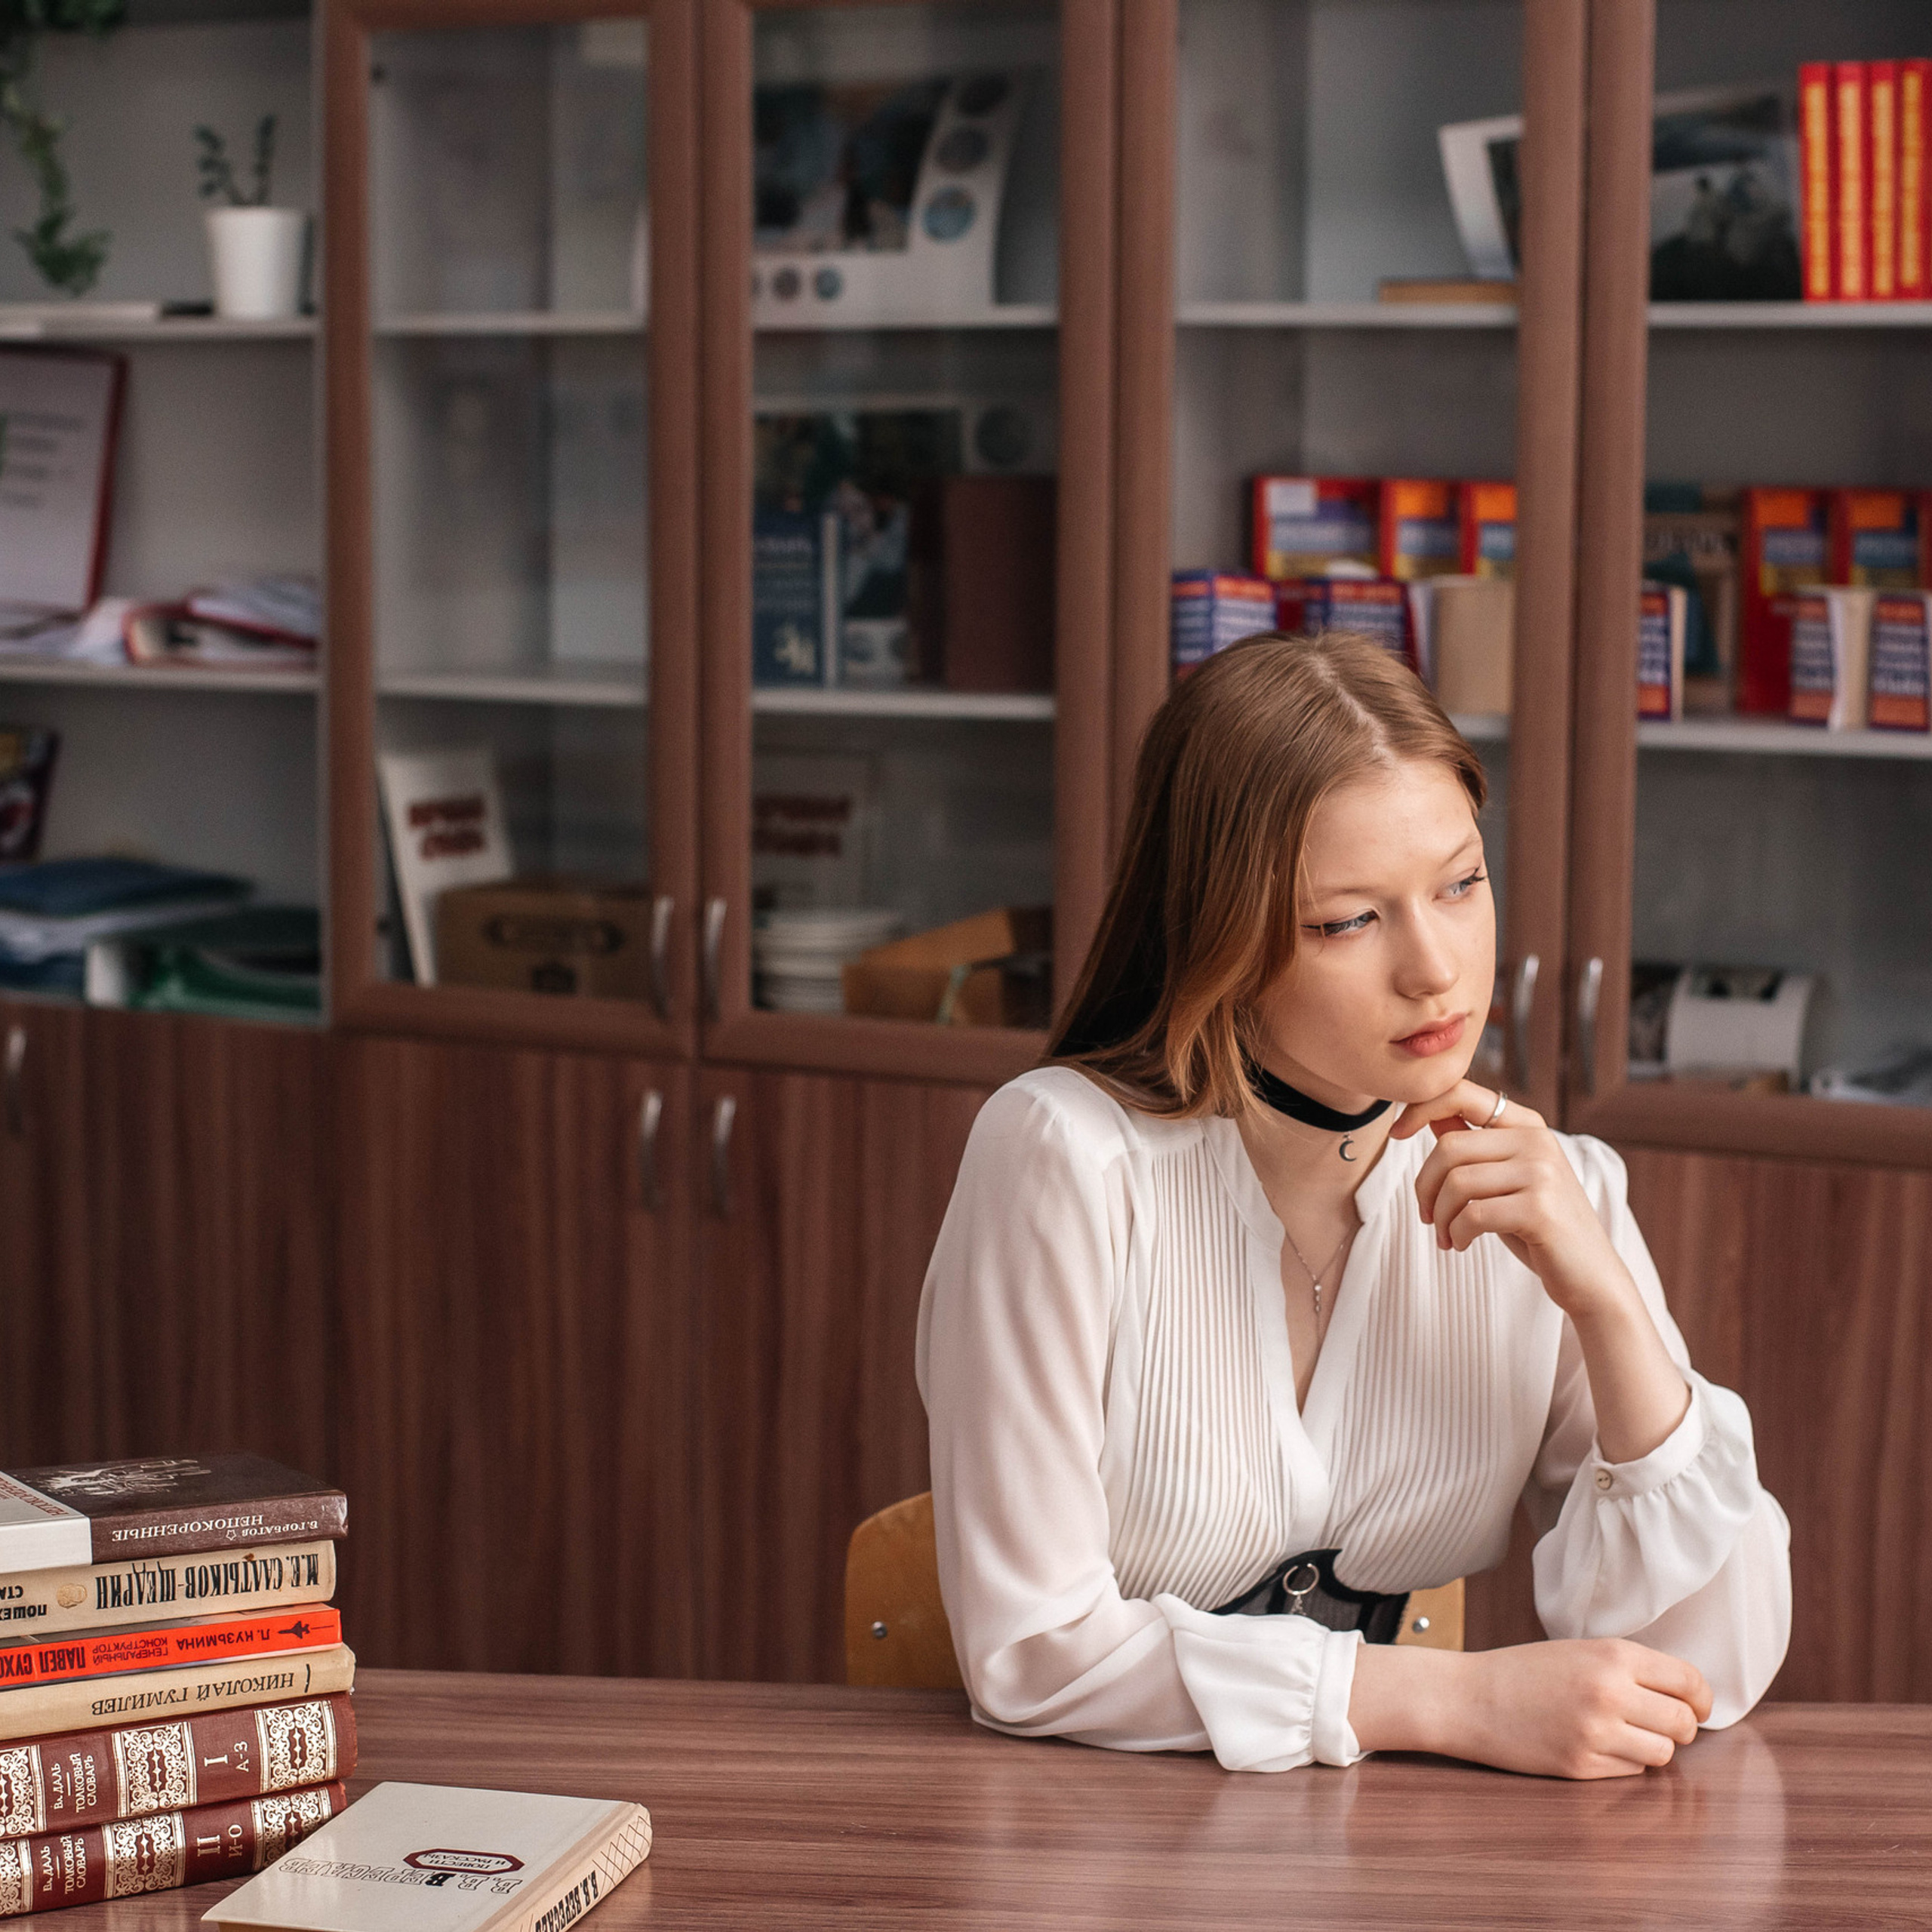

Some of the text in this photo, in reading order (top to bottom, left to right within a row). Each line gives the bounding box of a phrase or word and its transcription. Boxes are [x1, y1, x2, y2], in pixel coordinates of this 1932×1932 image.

[112, 1515, 264, 1542] НЕПОКОРЕННЫЕ
[95, 1558, 283, 1609] САЛТЫКОВ-ЩЕДРИН
[92, 1637, 168, 1654] КОНСТРУКТОР
[176, 1629, 254, 1651] КУЗЬМИНА
[38, 1647, 86, 1673] ПАВЕЛ
[92, 1647, 168, 1665] ГЕНЕРАЛЬНЫЙ
[91, 1672, 294, 1716] НИКОЛАЙ ГУМИЛЕВ
[51, 1763, 64, 1794] ДАЛЬ
[69, 1752, 85, 1813] ТОЛКОВЫЙ
[84, 1755, 97, 1807] СЛОВАРЬ
[41, 1846, 54, 1876] ДАЛЬ
[60, 1835, 75, 1895] ТОЛКОВЫЙ
[75, 1838, 87, 1888] СЛОВАРЬ
[279, 1857, 457, 1887] ВЕРЕСАЕВ
[423, 1853, 492, 1864] РАССКАЗЫ
[429, 1859, 491, 1870] ПОВЕСТИ
